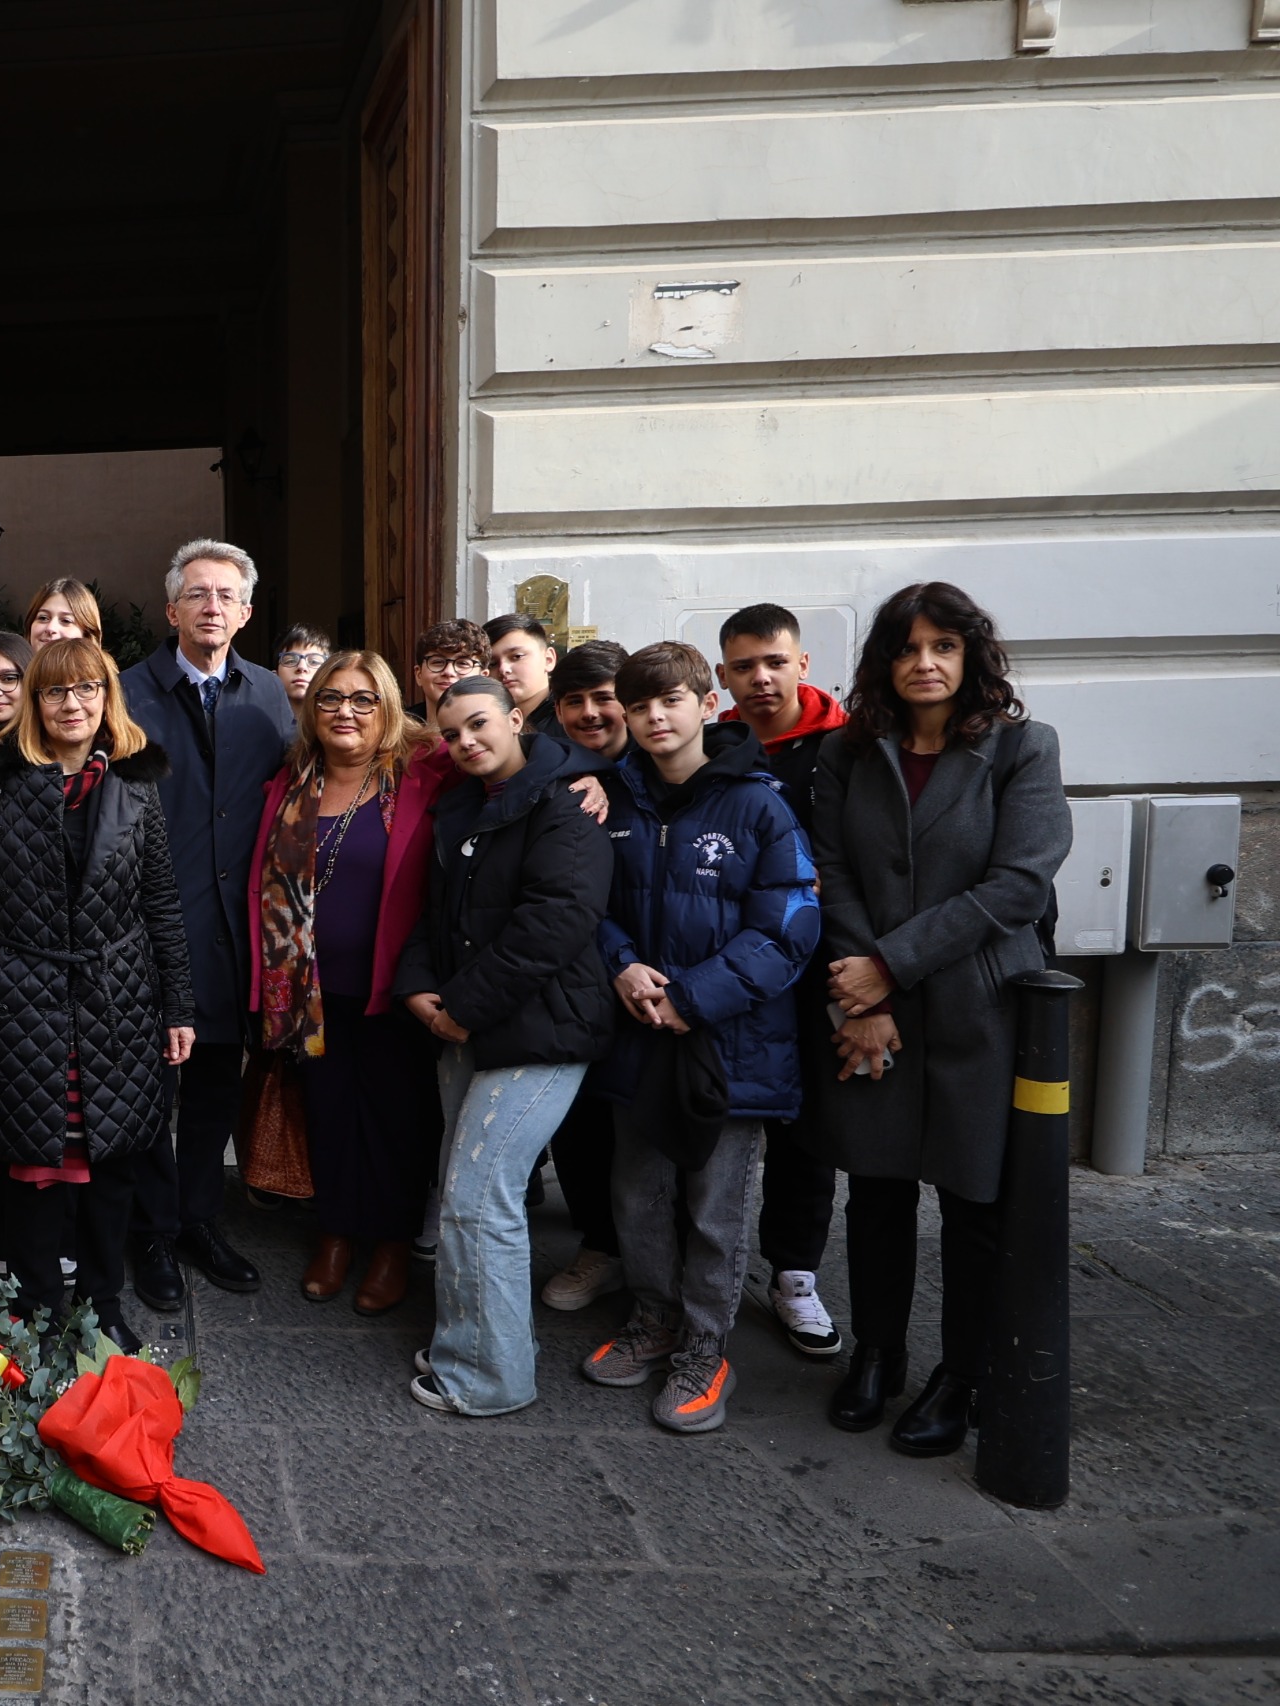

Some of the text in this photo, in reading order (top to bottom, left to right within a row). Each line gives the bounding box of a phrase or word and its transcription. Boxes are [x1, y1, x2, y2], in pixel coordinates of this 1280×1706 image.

[608, 829, 631, 839] eus
[702, 832, 735, 854] PARTENOPE
[695, 867, 721, 878] NAPOLI
